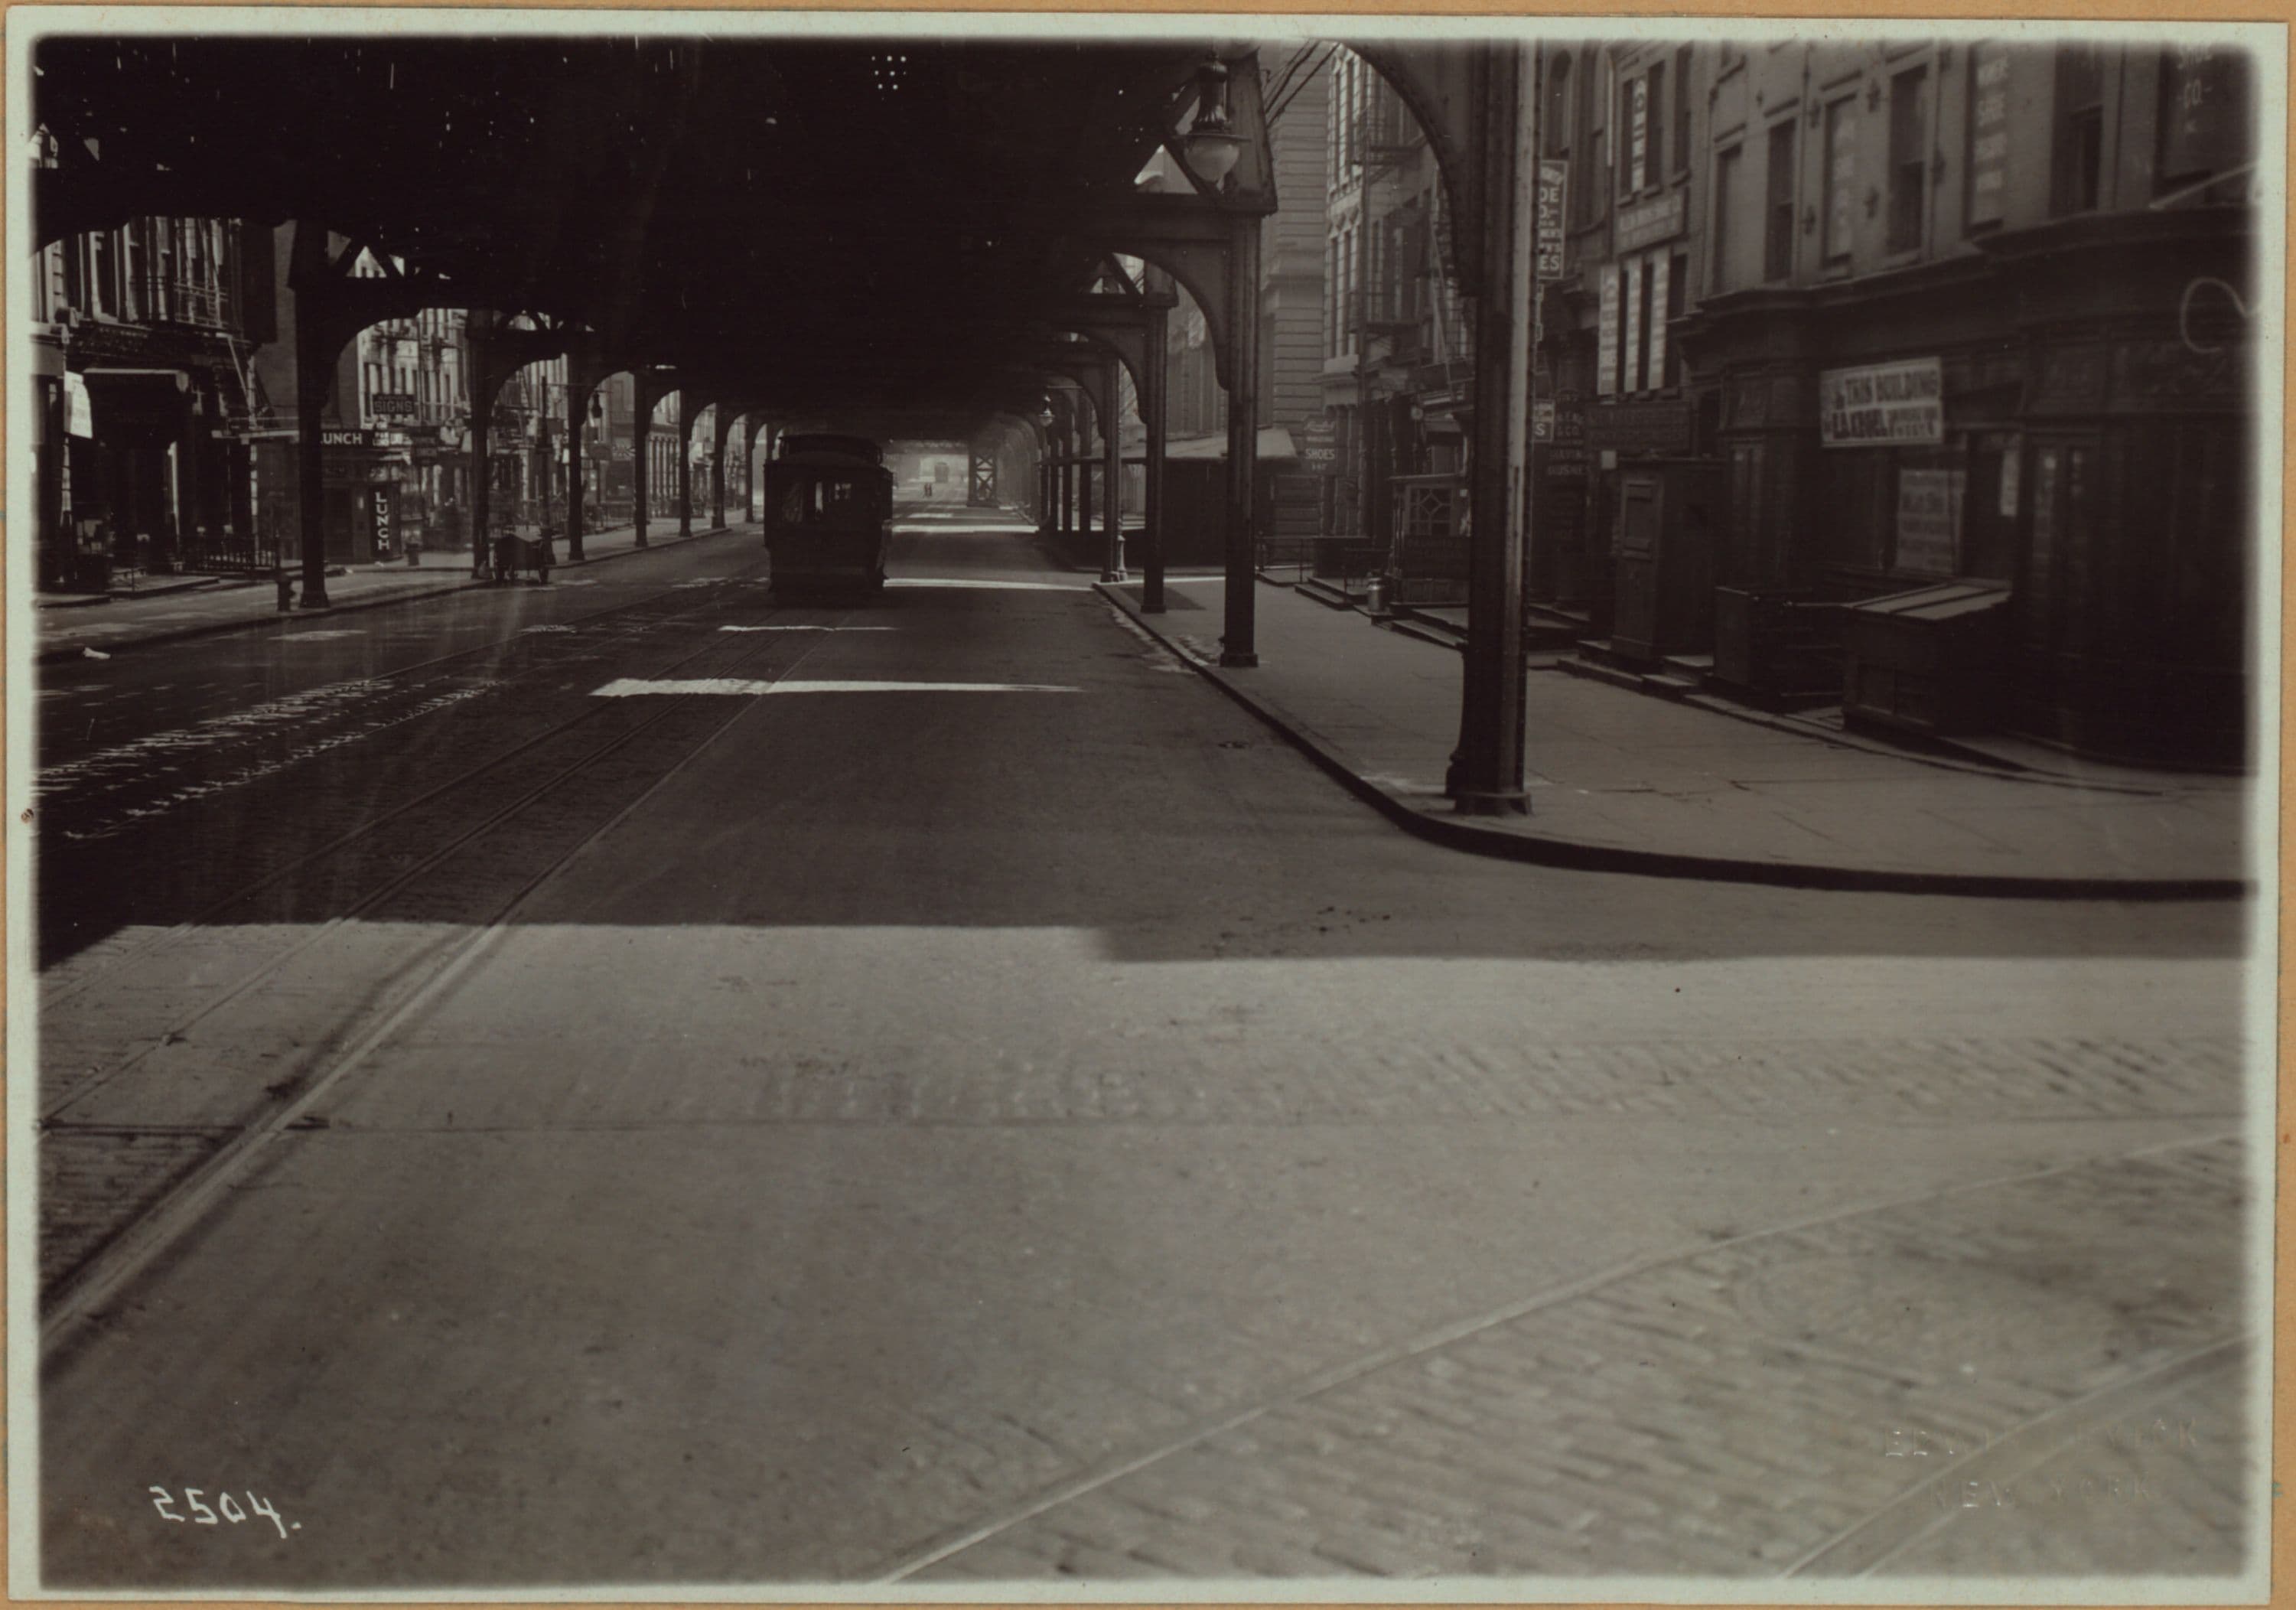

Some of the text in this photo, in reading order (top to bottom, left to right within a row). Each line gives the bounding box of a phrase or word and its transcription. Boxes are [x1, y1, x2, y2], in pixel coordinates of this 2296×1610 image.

[374, 400, 413, 413] SIGNS
[320, 432, 363, 446] UNCH
[374, 490, 391, 551] LUNCH
